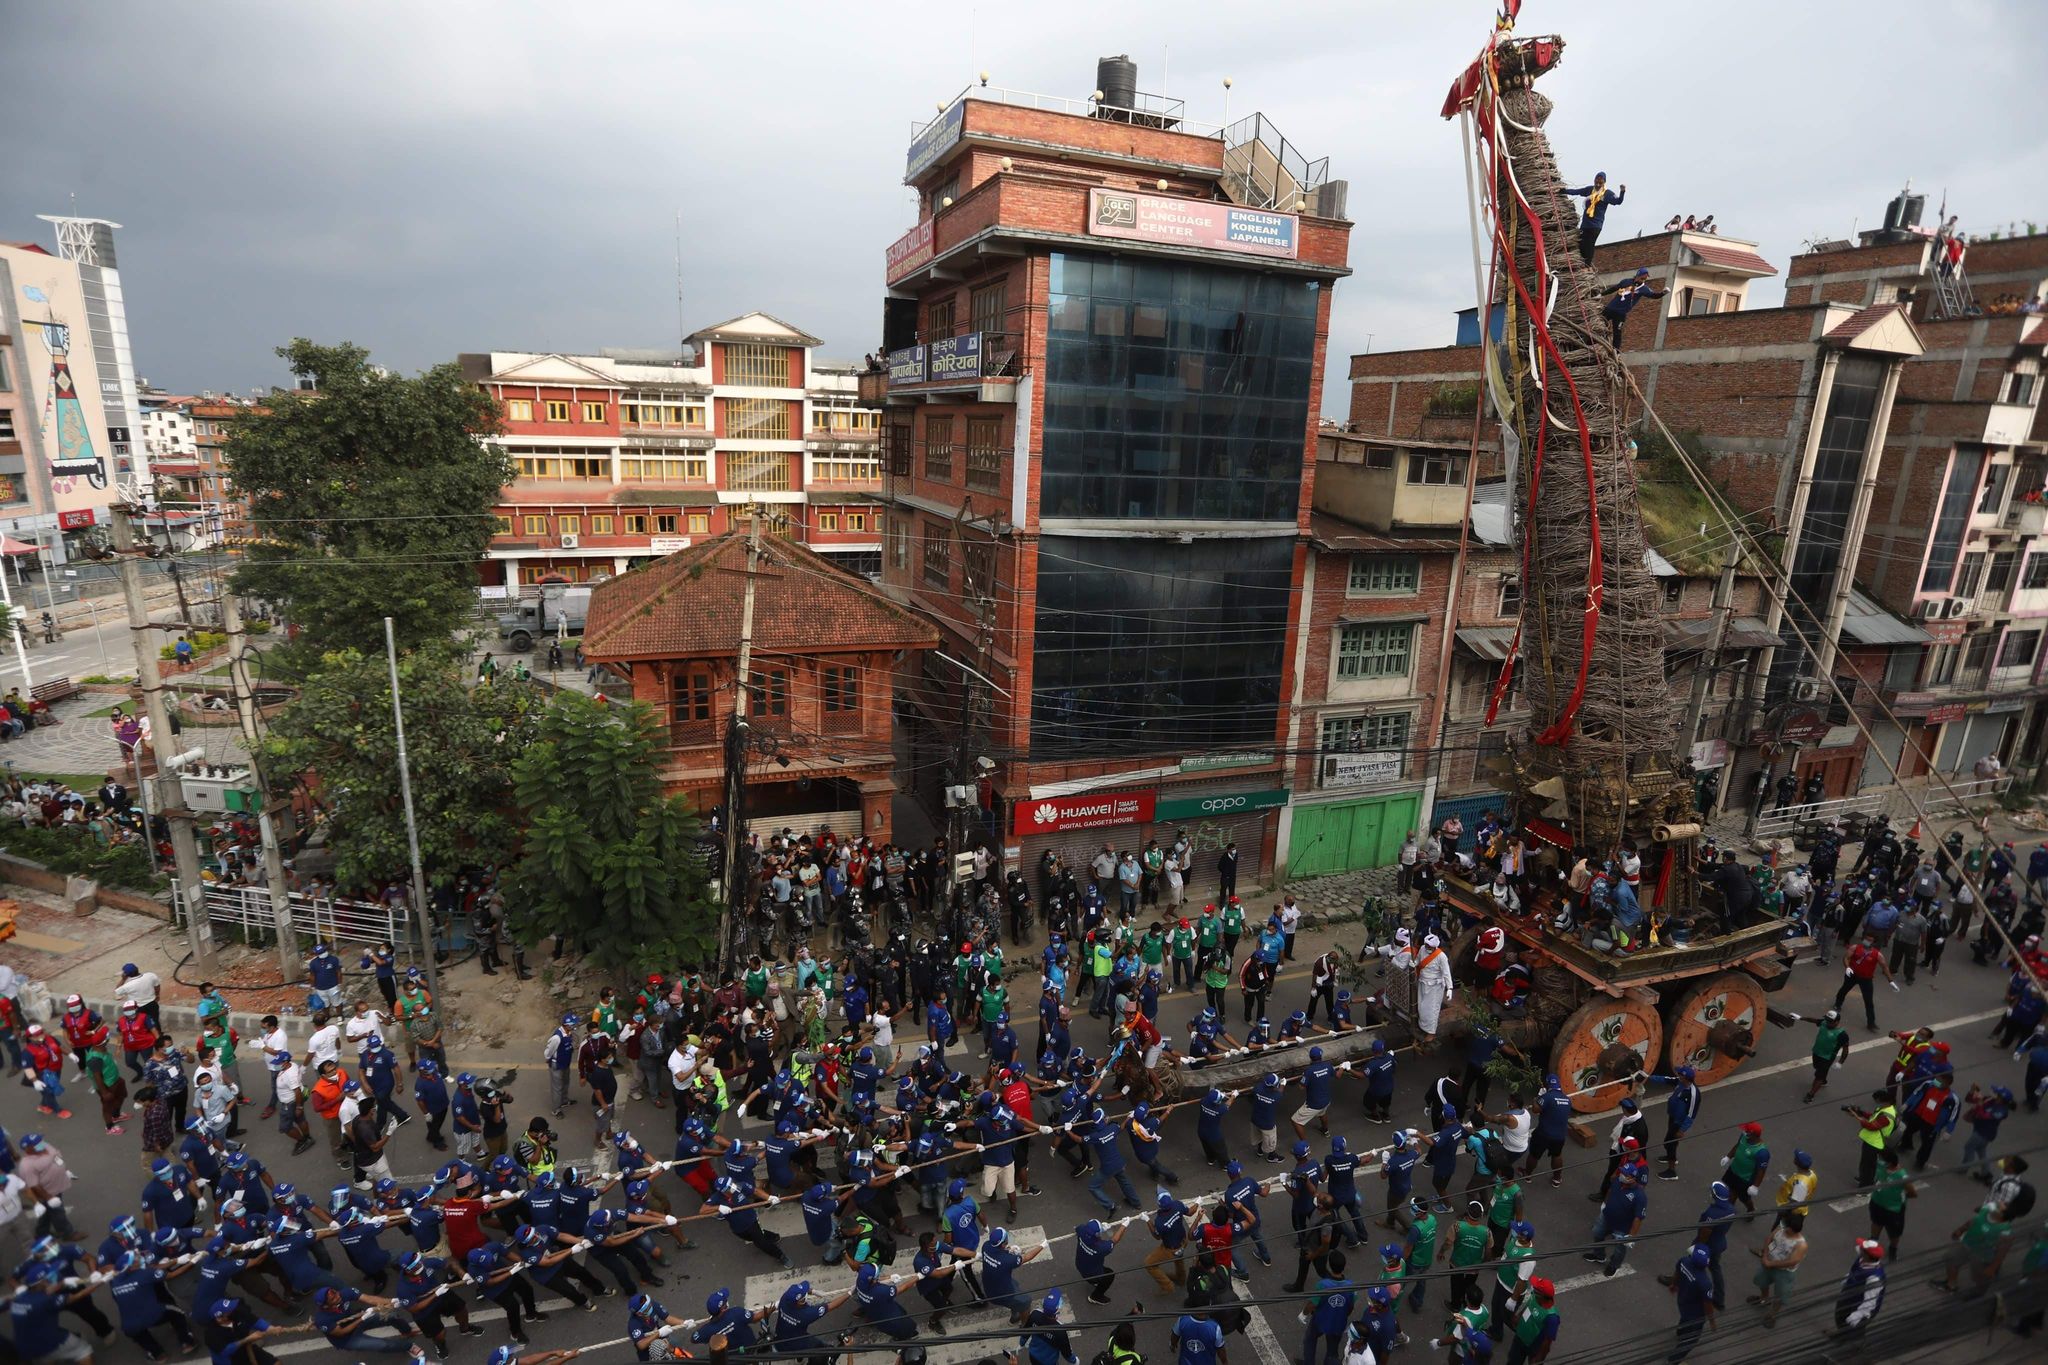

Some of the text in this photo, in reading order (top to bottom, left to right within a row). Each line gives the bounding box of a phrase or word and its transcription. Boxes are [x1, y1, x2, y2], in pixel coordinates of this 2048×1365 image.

[935, 120, 960, 152] CENTER
[1110, 201, 1131, 211] GLC
[1140, 199, 1185, 212] GRACE
[1140, 211, 1213, 228] LANGUAGE
[1231, 211, 1281, 226] ENGLISH
[1140, 223, 1193, 236] CENTER
[1231, 223, 1278, 236] KOREAN
[1231, 234, 1289, 247] JAPANESE
[932, 338, 957, 355] 한국어
[889, 360, 923, 379] जापानीज
[932, 354, 978, 373] कोरियन
[1338, 766, 1356, 774] NEM
[1117, 805, 1139, 813] PHONES
[1201, 796, 1246, 812] oppo
[1060, 804, 1111, 819] HUAWEI
[1059, 816, 1134, 830] DIGITAL GADGETS HOUSE
